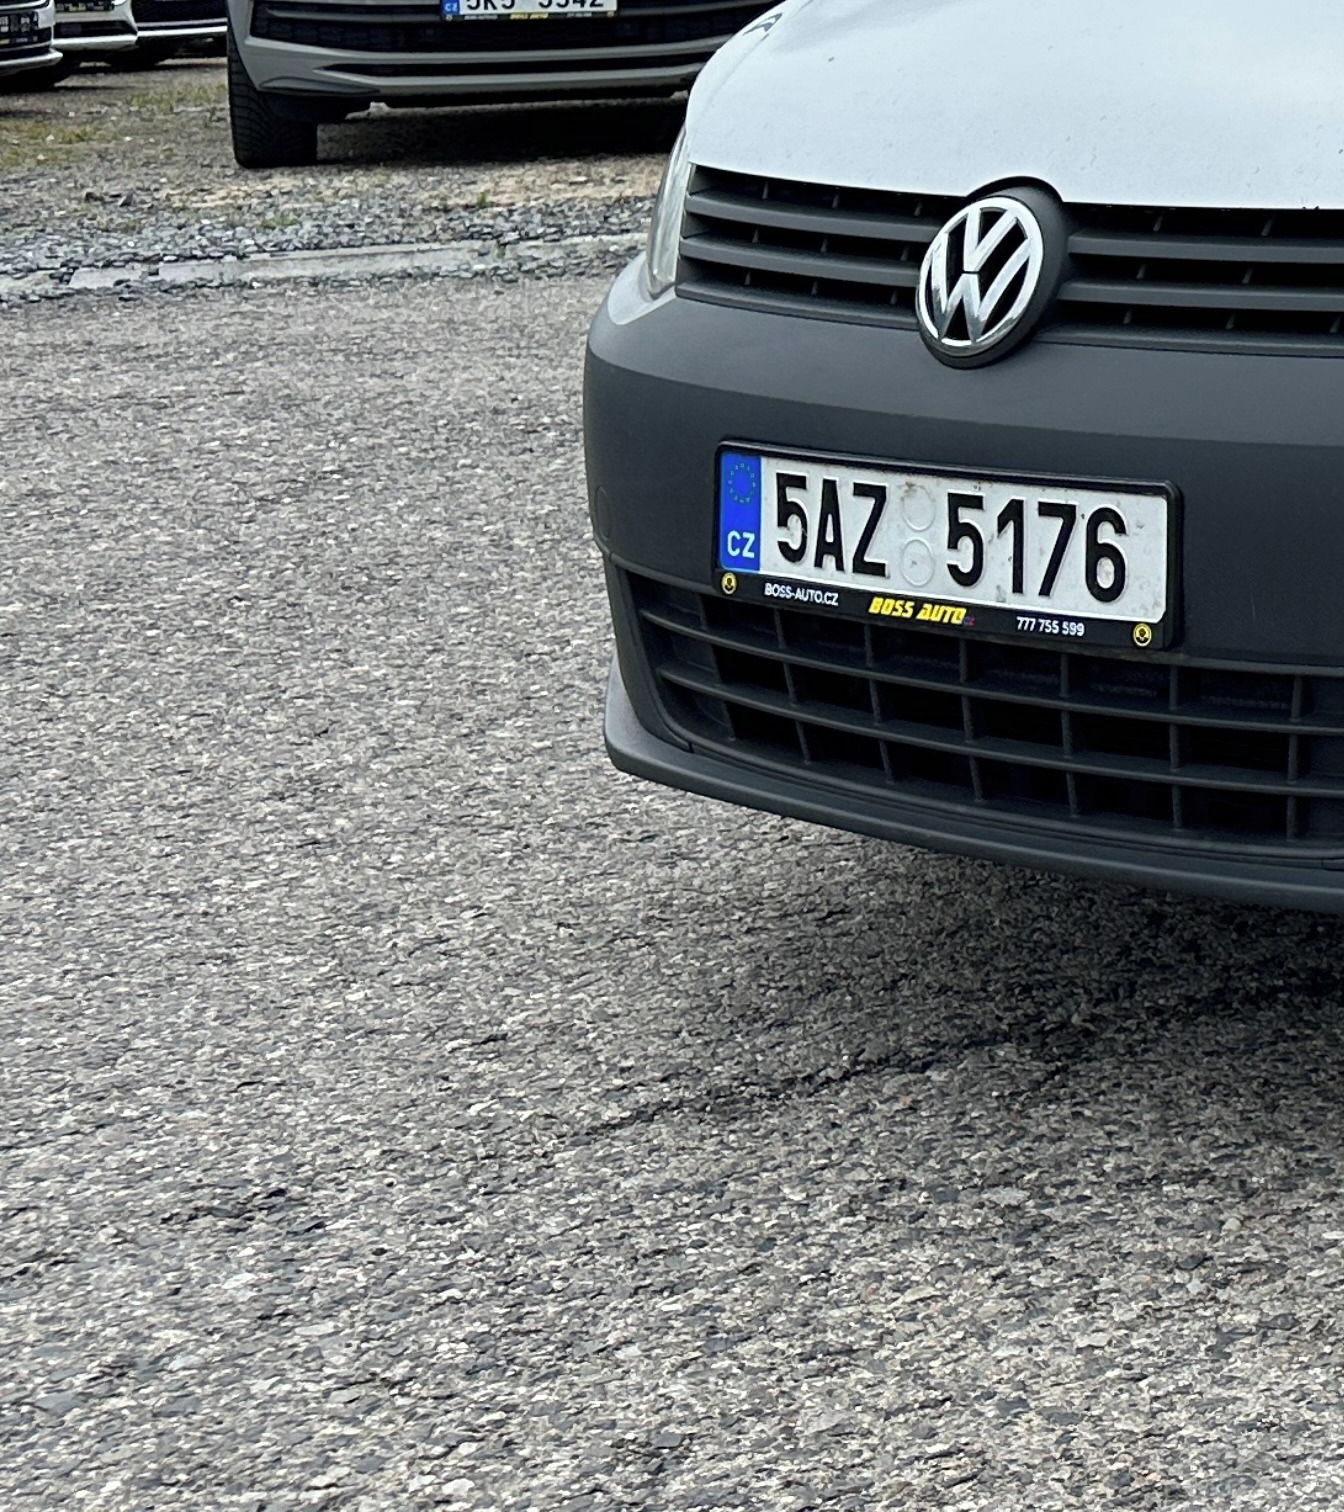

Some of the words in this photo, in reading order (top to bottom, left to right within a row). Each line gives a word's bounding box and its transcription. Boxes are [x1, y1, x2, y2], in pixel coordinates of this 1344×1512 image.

[444, 2, 458, 12] CZ
[727, 529, 755, 558] CZ
[776, 472, 887, 578] 5AZ
[946, 491, 1127, 603] 5176
[764, 582, 839, 607] BOSS-AUTO.CZ
[867, 596, 913, 618] BOSS
[916, 604, 967, 625] AUTO
[1016, 615, 1036, 632] 777
[1038, 618, 1060, 635] 755
[1061, 620, 1085, 637] 599
